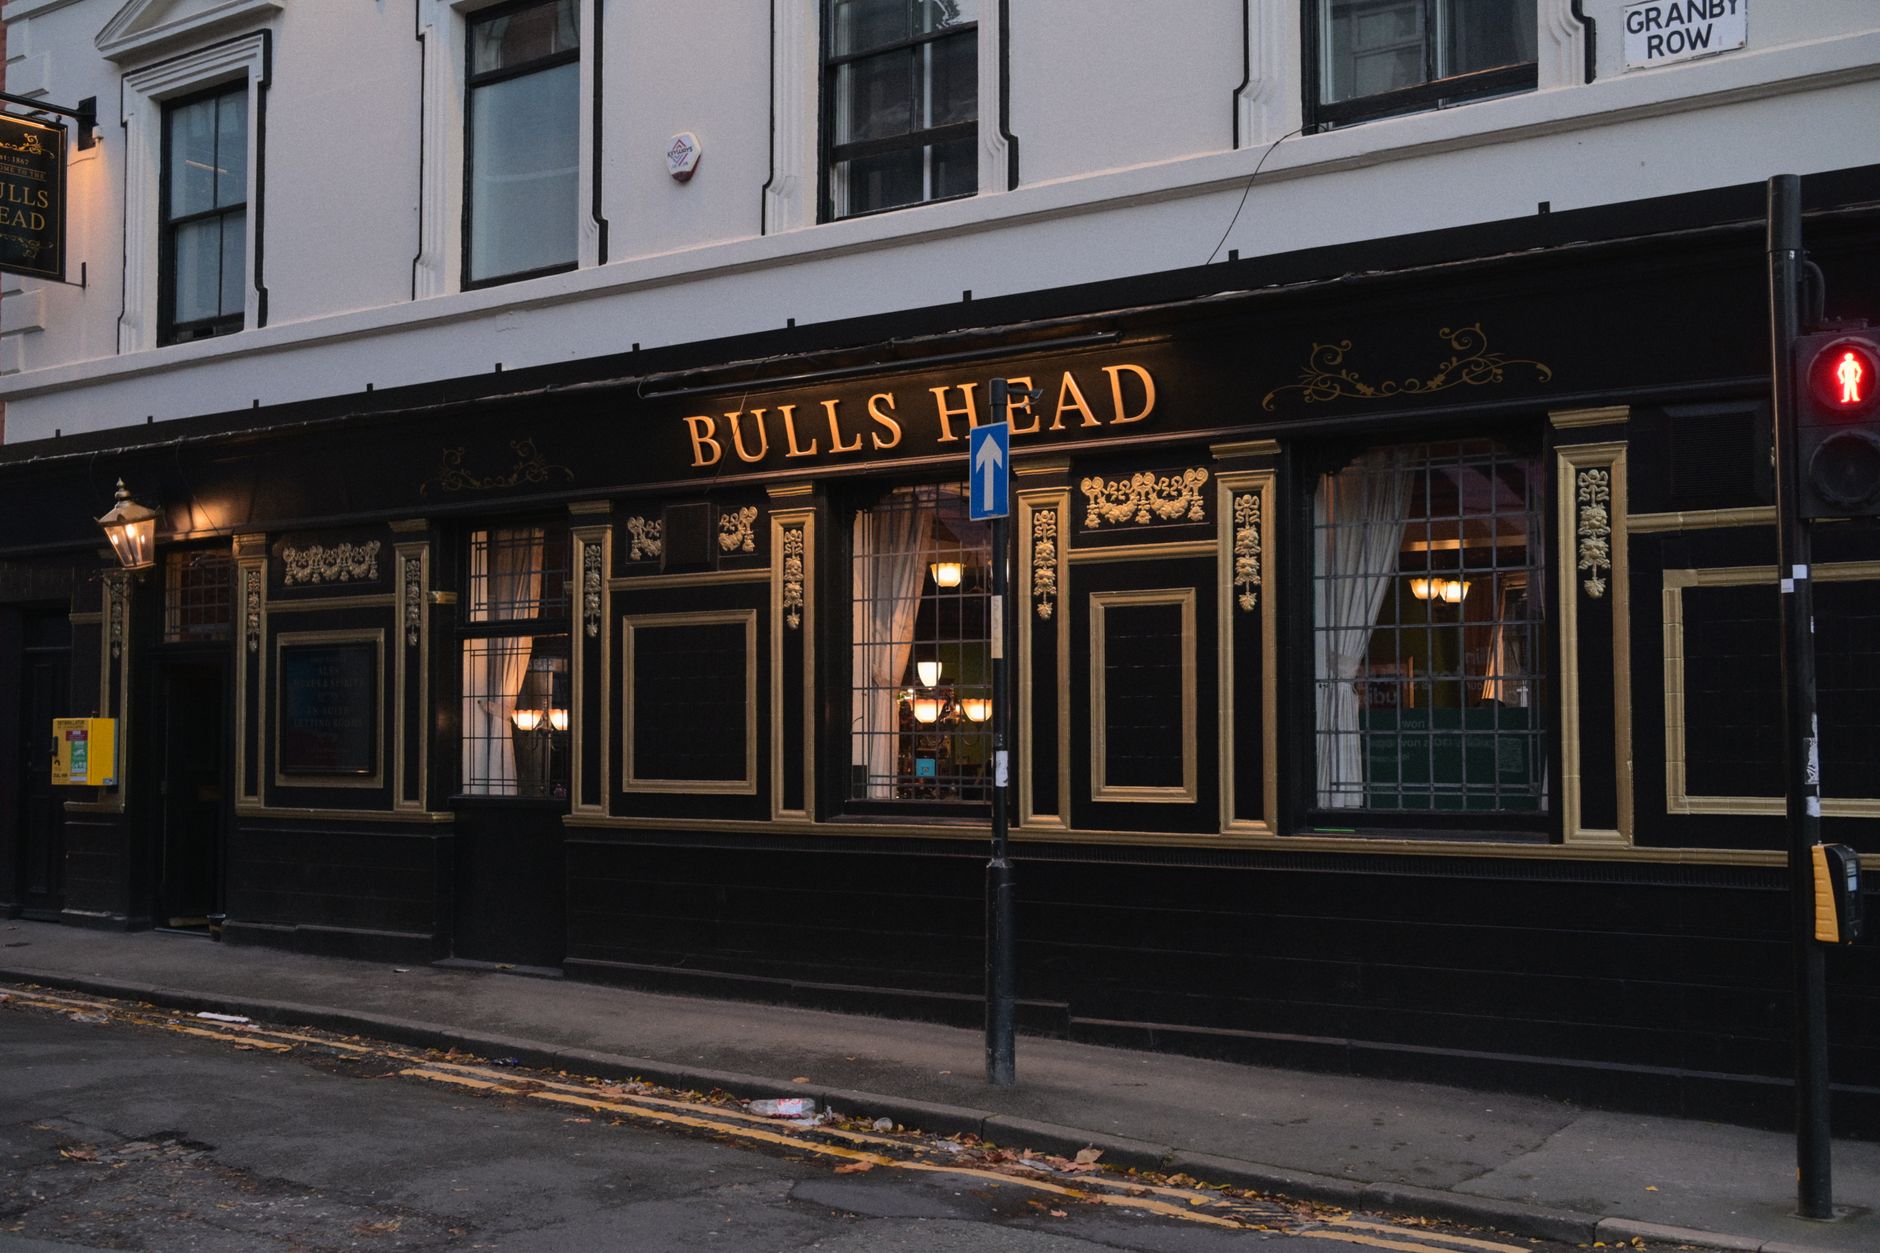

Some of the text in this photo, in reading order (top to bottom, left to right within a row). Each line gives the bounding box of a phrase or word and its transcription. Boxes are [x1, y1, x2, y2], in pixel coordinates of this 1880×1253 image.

[1626, 0, 1738, 34] GRANBY
[1647, 23, 1713, 59] ROW
[682, 363, 1156, 467] BULLS HEAD
